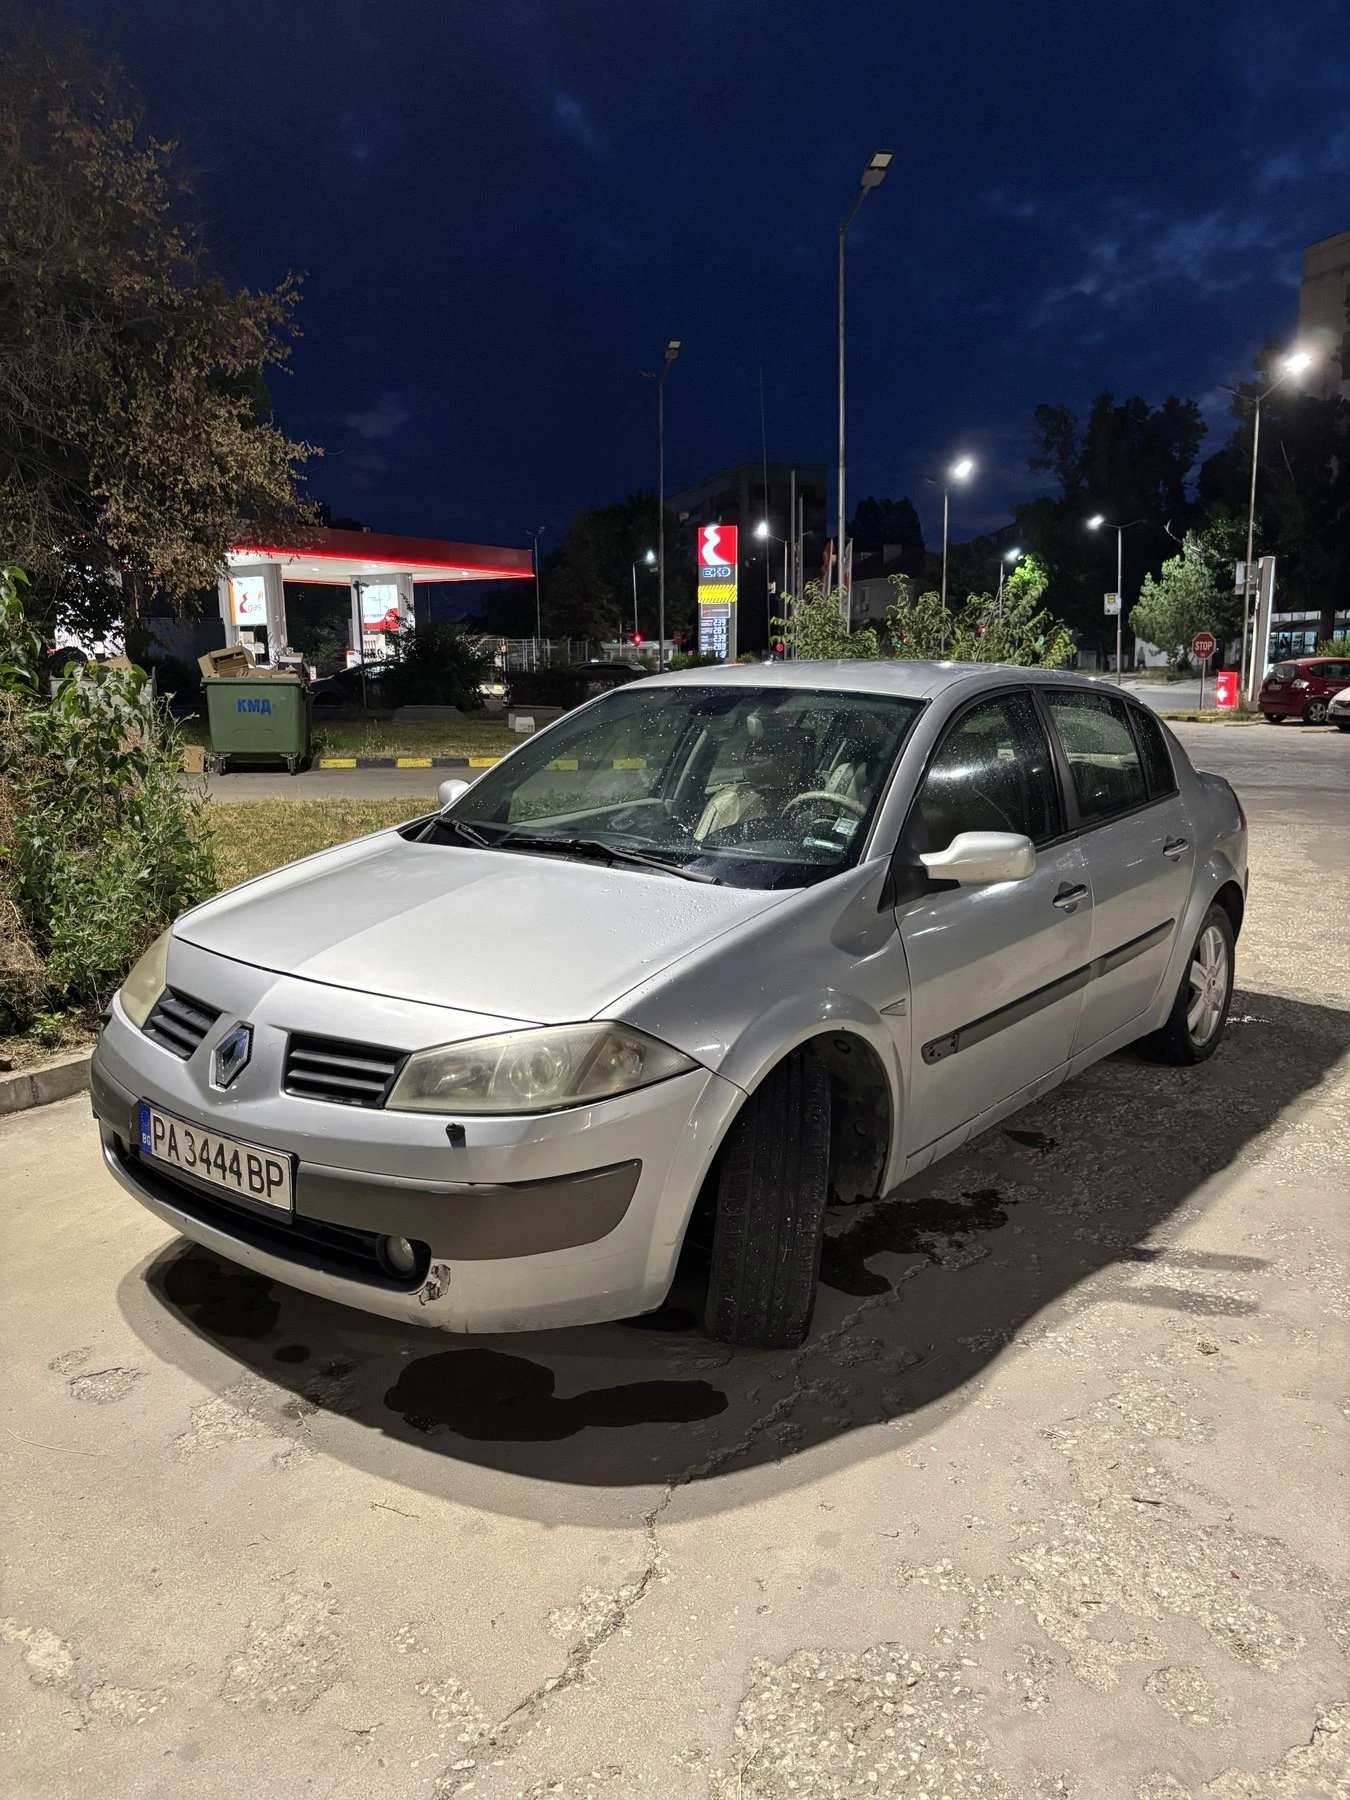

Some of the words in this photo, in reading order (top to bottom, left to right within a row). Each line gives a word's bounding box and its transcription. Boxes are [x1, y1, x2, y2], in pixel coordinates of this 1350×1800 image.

[703, 566, 731, 578] EKO
[1194, 641, 1213, 651] STOP
[237, 698, 272, 716] КМД
[142, 1132, 151, 1146] BG
